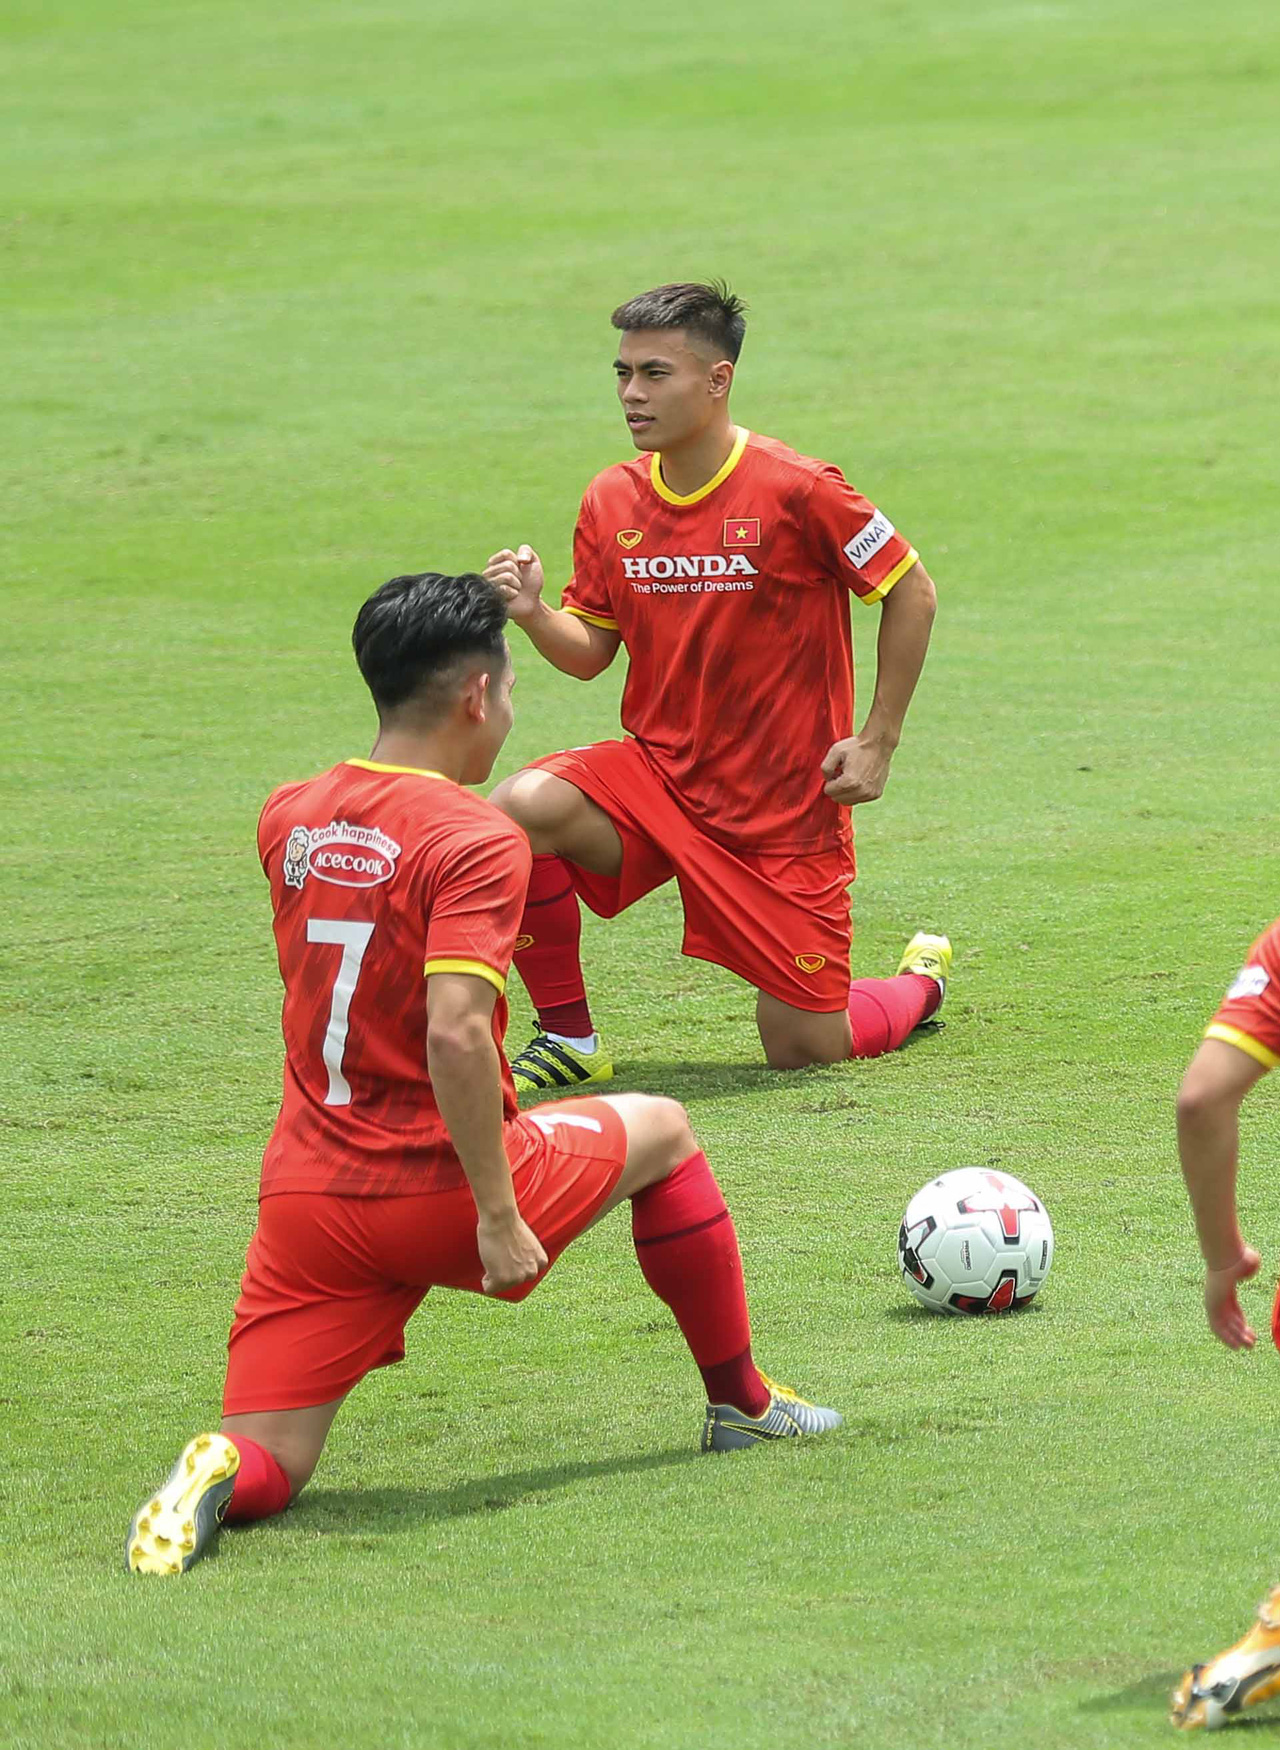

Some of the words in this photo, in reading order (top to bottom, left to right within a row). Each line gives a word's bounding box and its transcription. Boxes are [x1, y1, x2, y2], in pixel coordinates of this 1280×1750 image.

[621, 554, 759, 579] HONDA
[630, 582, 651, 594] The
[652, 582, 689, 594] Power
[690, 581, 703, 593] of
[704, 581, 754, 593] Dreams
[311, 825, 338, 843] Cook
[341, 824, 398, 857] happiness
[306, 918, 376, 1106] 7
